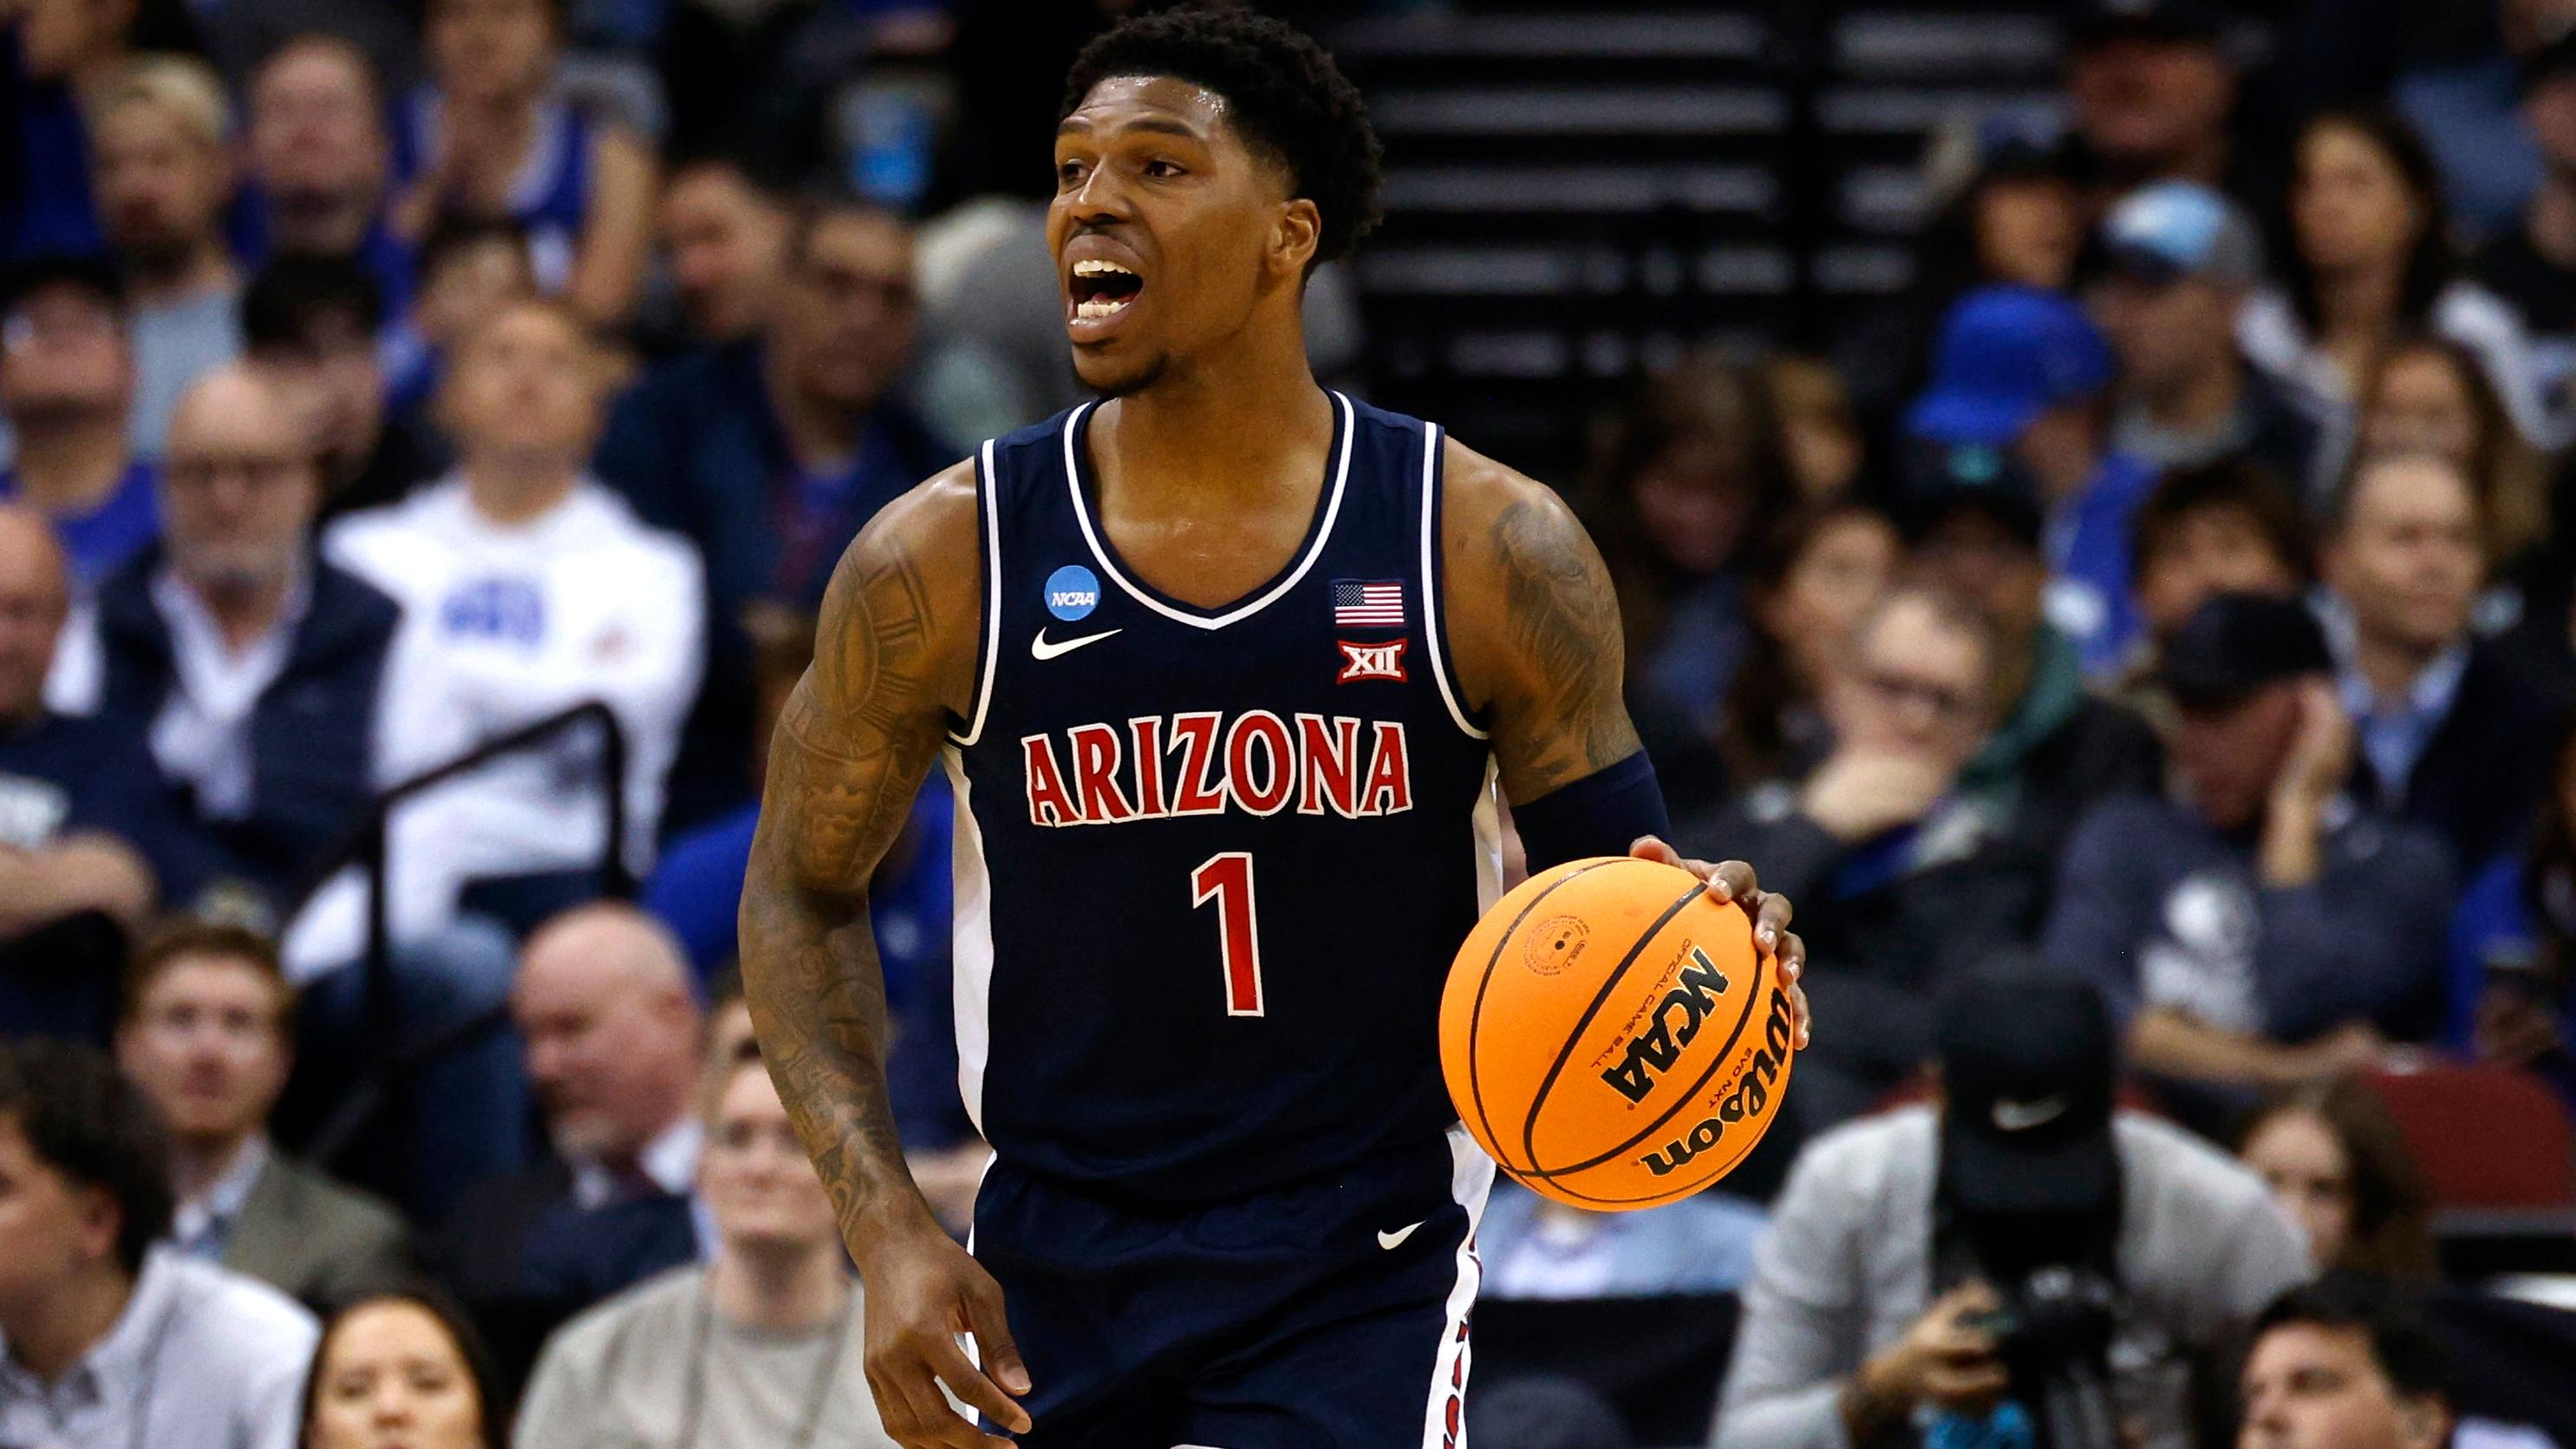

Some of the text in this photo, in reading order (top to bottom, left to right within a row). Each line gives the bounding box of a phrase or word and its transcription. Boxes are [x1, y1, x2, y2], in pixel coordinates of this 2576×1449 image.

[1051, 591, 1096, 607] NCAA
[1341, 643, 1403, 679] XII
[1021, 709, 1412, 827] ARIZONA
[1190, 852, 1264, 1017] 1
[1591, 938, 1692, 1067] OFFICIAL GAME BALL
[1600, 944, 1730, 1105] NCAA
[1640, 987, 1791, 1177] Wilson
[1708, 1048, 1753, 1108] EVO NXT
